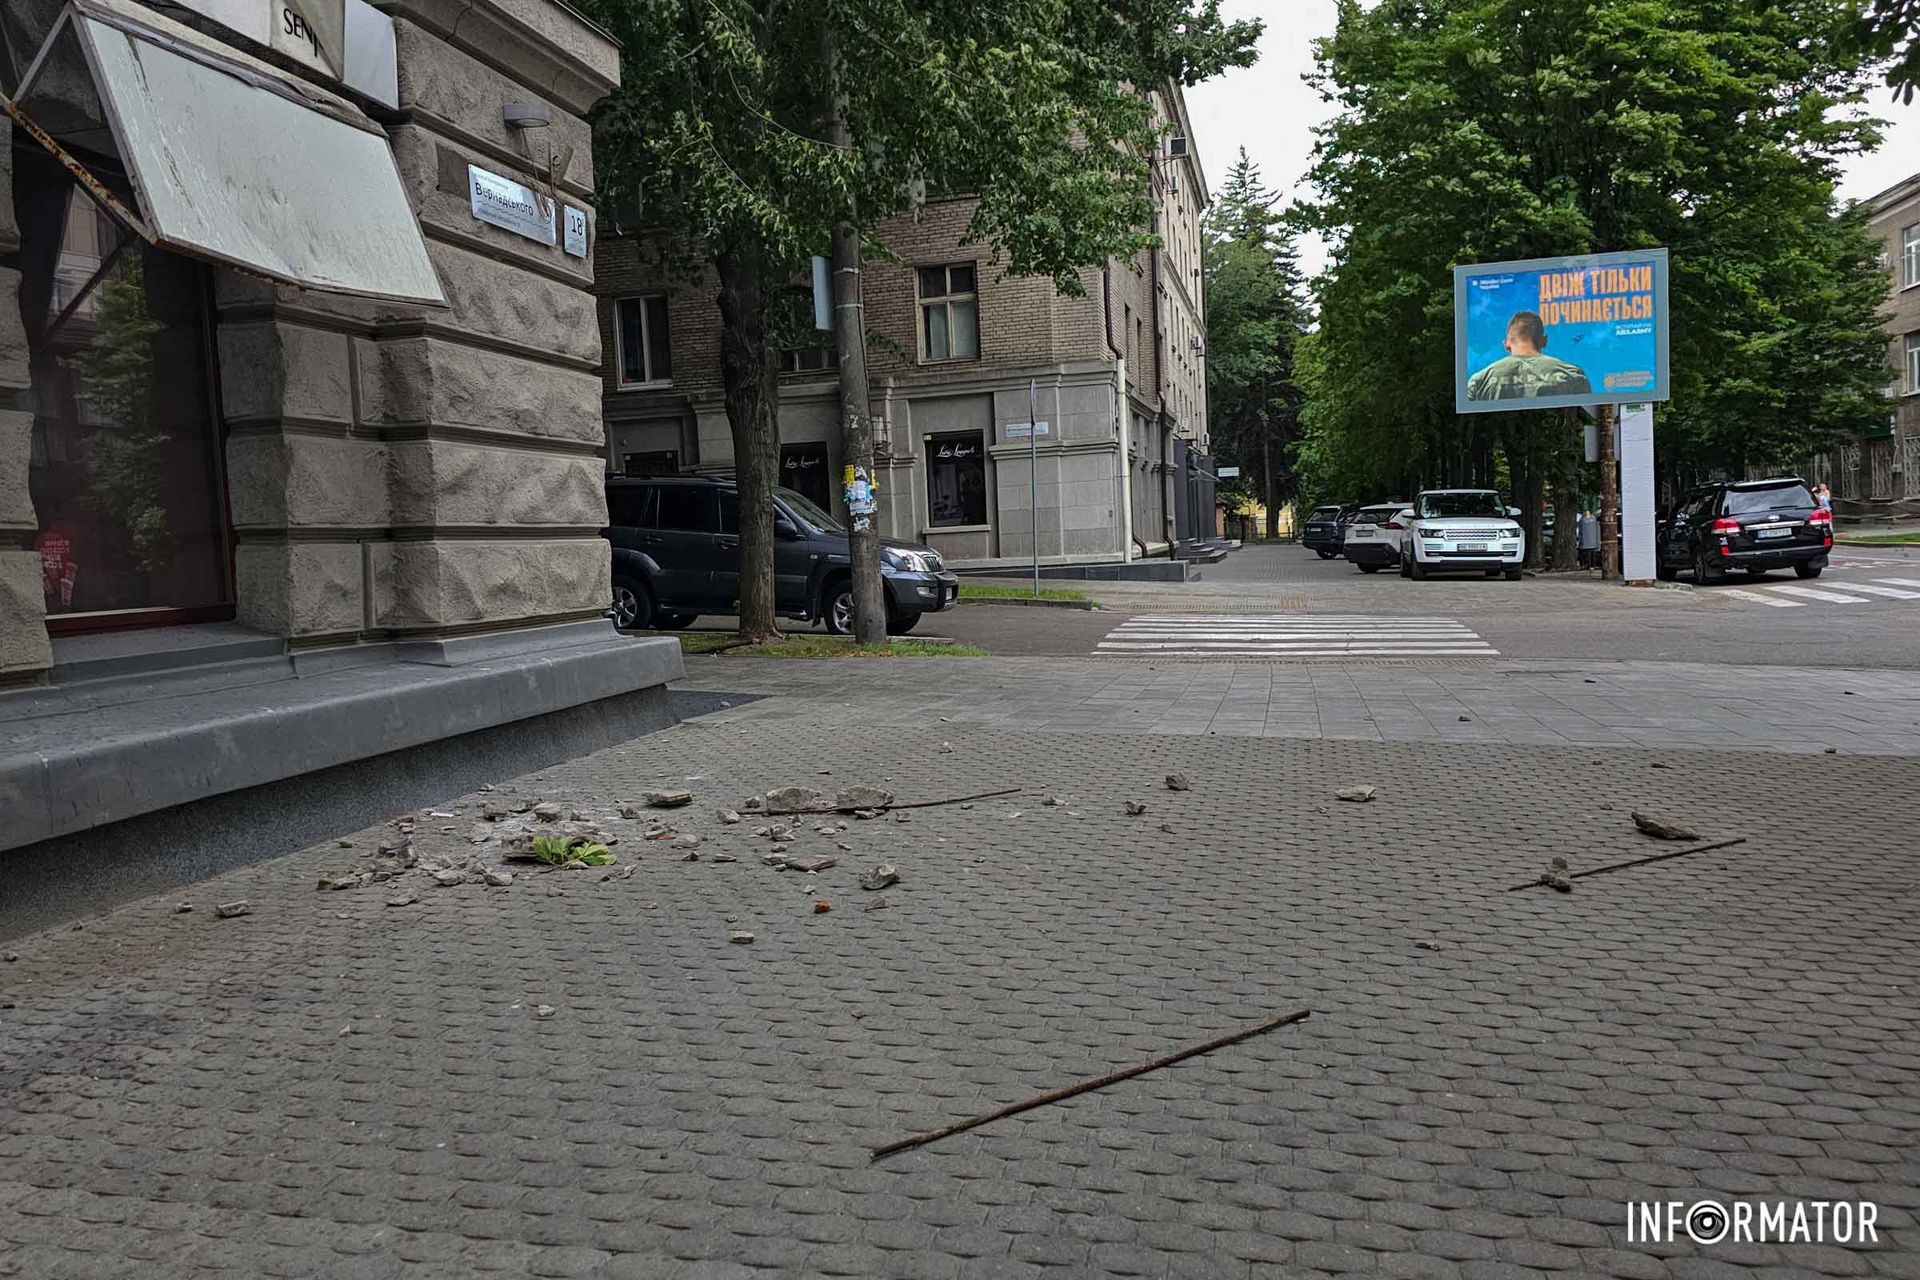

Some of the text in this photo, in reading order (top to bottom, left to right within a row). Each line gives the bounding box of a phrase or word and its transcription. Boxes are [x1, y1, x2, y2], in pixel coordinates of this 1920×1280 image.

[571, 215, 583, 236] 18
[1539, 266, 1652, 301] ДВІЖ ТІЛЬКИ
[1540, 295, 1652, 325] ПОЧИНАЄТЬСЯ
